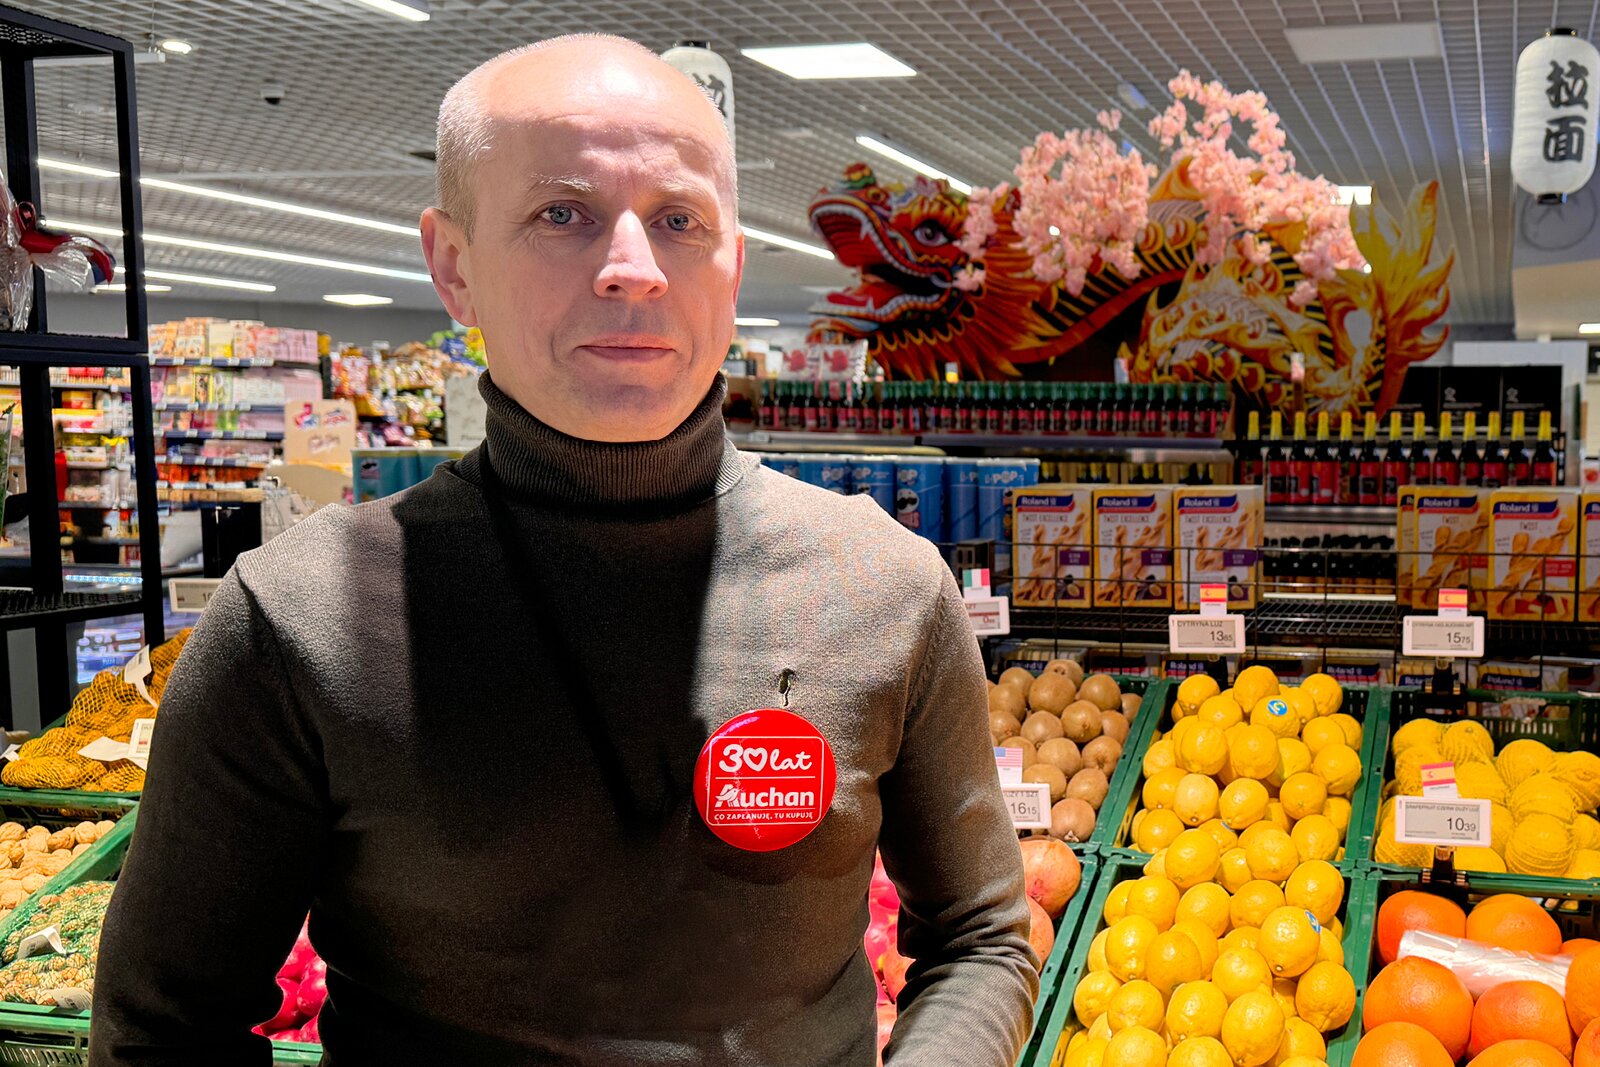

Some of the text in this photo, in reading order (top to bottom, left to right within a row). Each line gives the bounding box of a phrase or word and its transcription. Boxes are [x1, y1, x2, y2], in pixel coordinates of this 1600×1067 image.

[1543, 60, 1590, 163] 拉面
[1021, 496, 1049, 505] Roland
[1102, 498, 1130, 507] Roland
[1183, 498, 1211, 507] Roland
[1423, 498, 1452, 507] Roland
[1499, 503, 1530, 512] Roland
[769, 748, 813, 772] lat
[714, 783, 814, 808] Auchan
[774, 812, 785, 820] TU
[785, 811, 813, 820] KUPUJĘ
[1447, 817, 1476, 832] 1039
